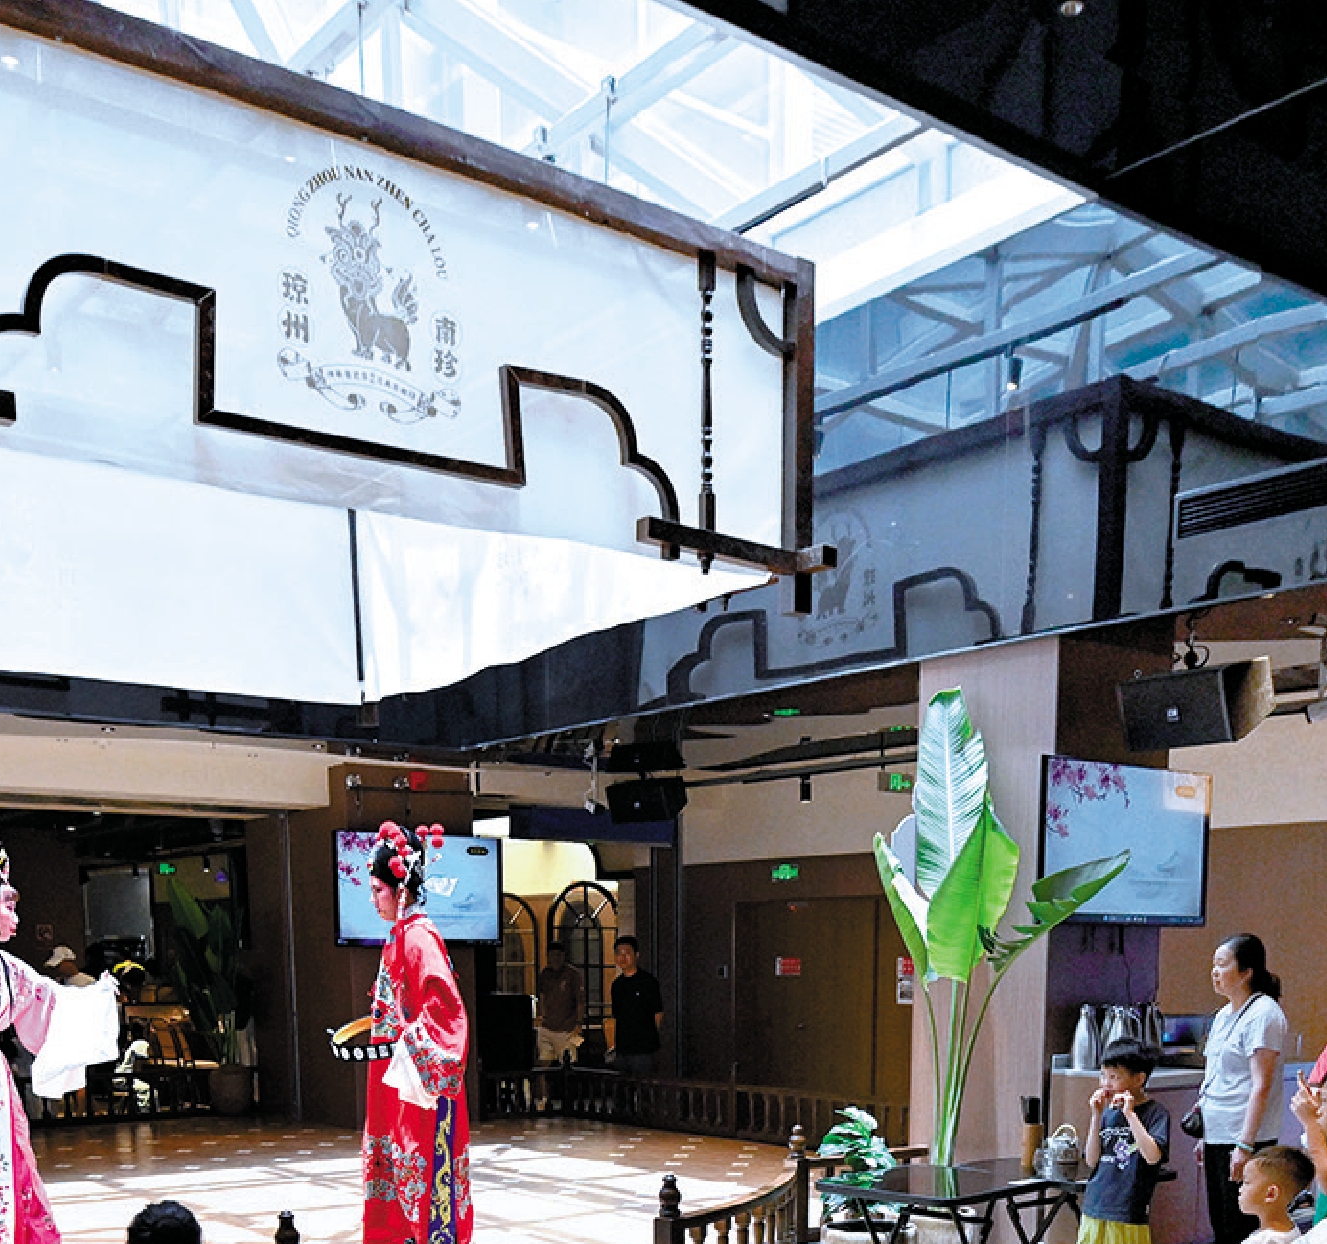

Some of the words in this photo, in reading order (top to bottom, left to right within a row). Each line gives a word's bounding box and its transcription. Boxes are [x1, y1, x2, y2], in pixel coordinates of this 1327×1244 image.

[306, 166, 342, 194] ZHOU
[344, 165, 374, 182] NAN
[377, 174, 414, 210] ZHEN
[412, 208, 435, 244] CHA
[430, 246, 448, 280] LOU
